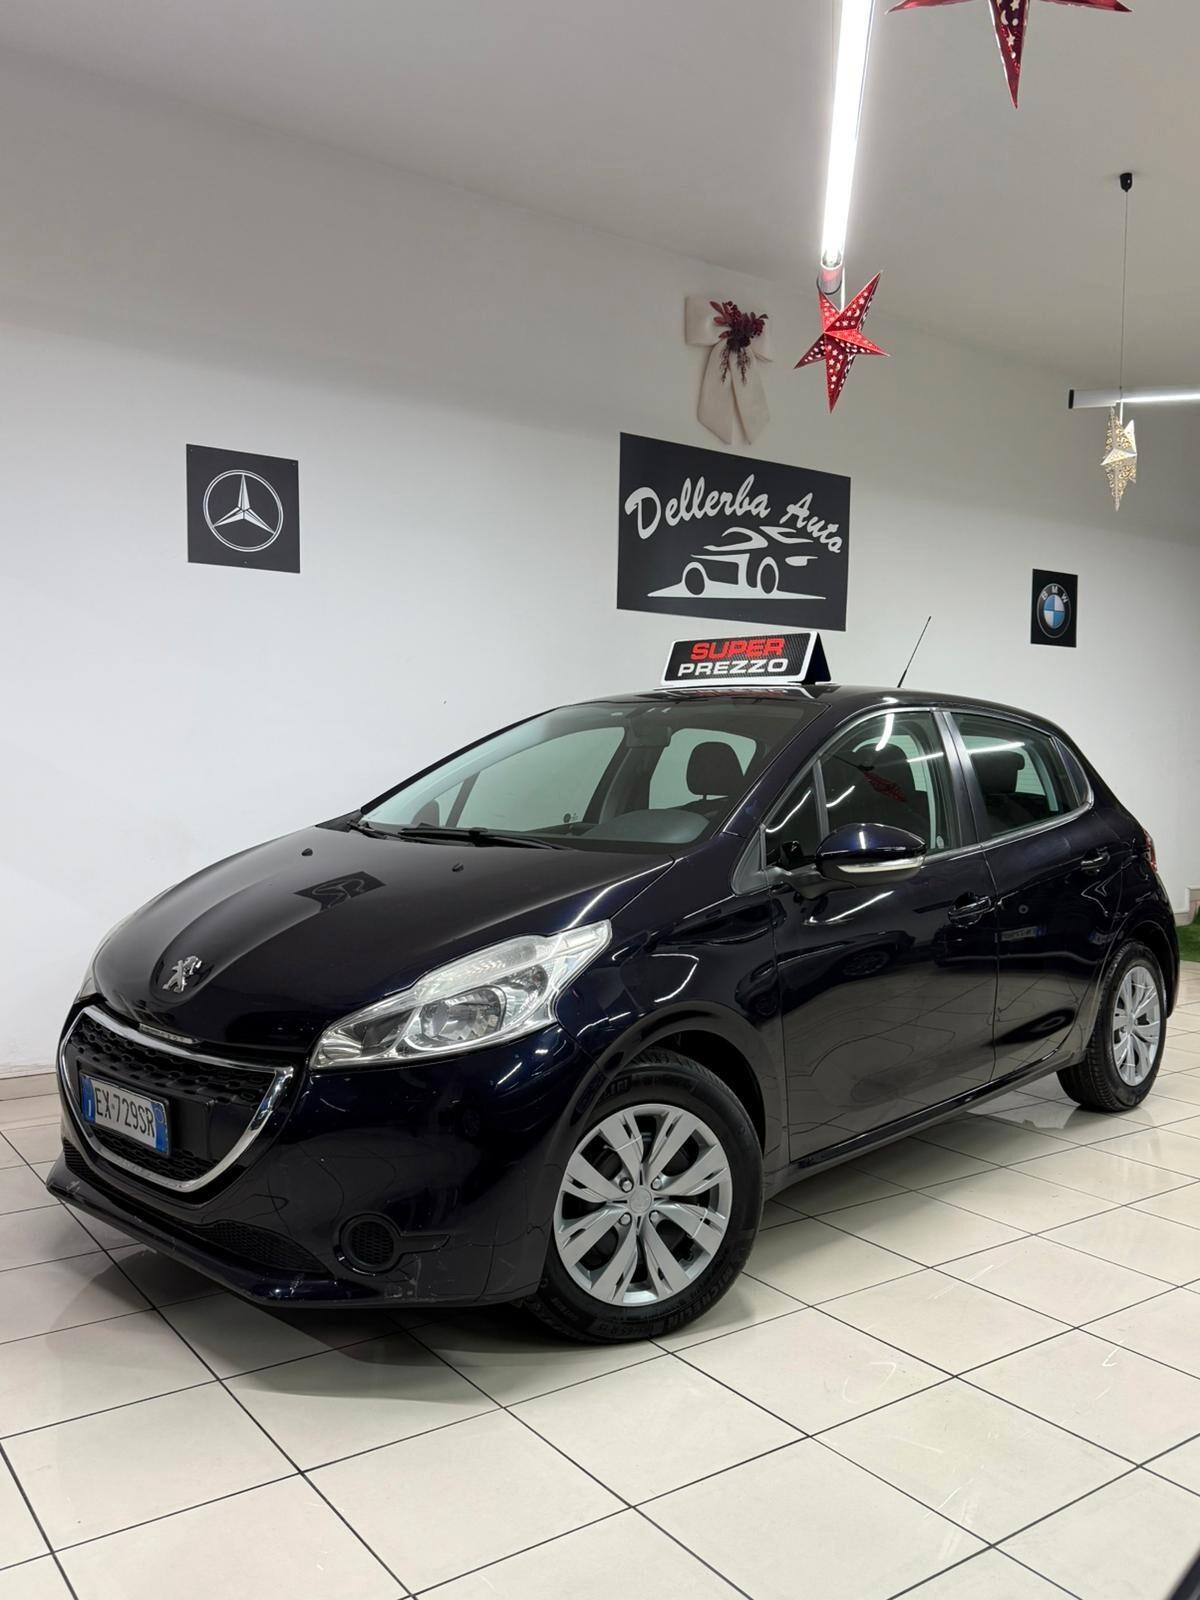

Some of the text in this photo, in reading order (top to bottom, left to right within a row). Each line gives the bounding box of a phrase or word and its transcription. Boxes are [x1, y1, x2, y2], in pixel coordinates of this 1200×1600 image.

[624, 473, 843, 553] Dellerba Auto
[1041, 585, 1069, 603] BMW
[690, 637, 786, 660] SUPER
[677, 658, 789, 677] PREZZO
